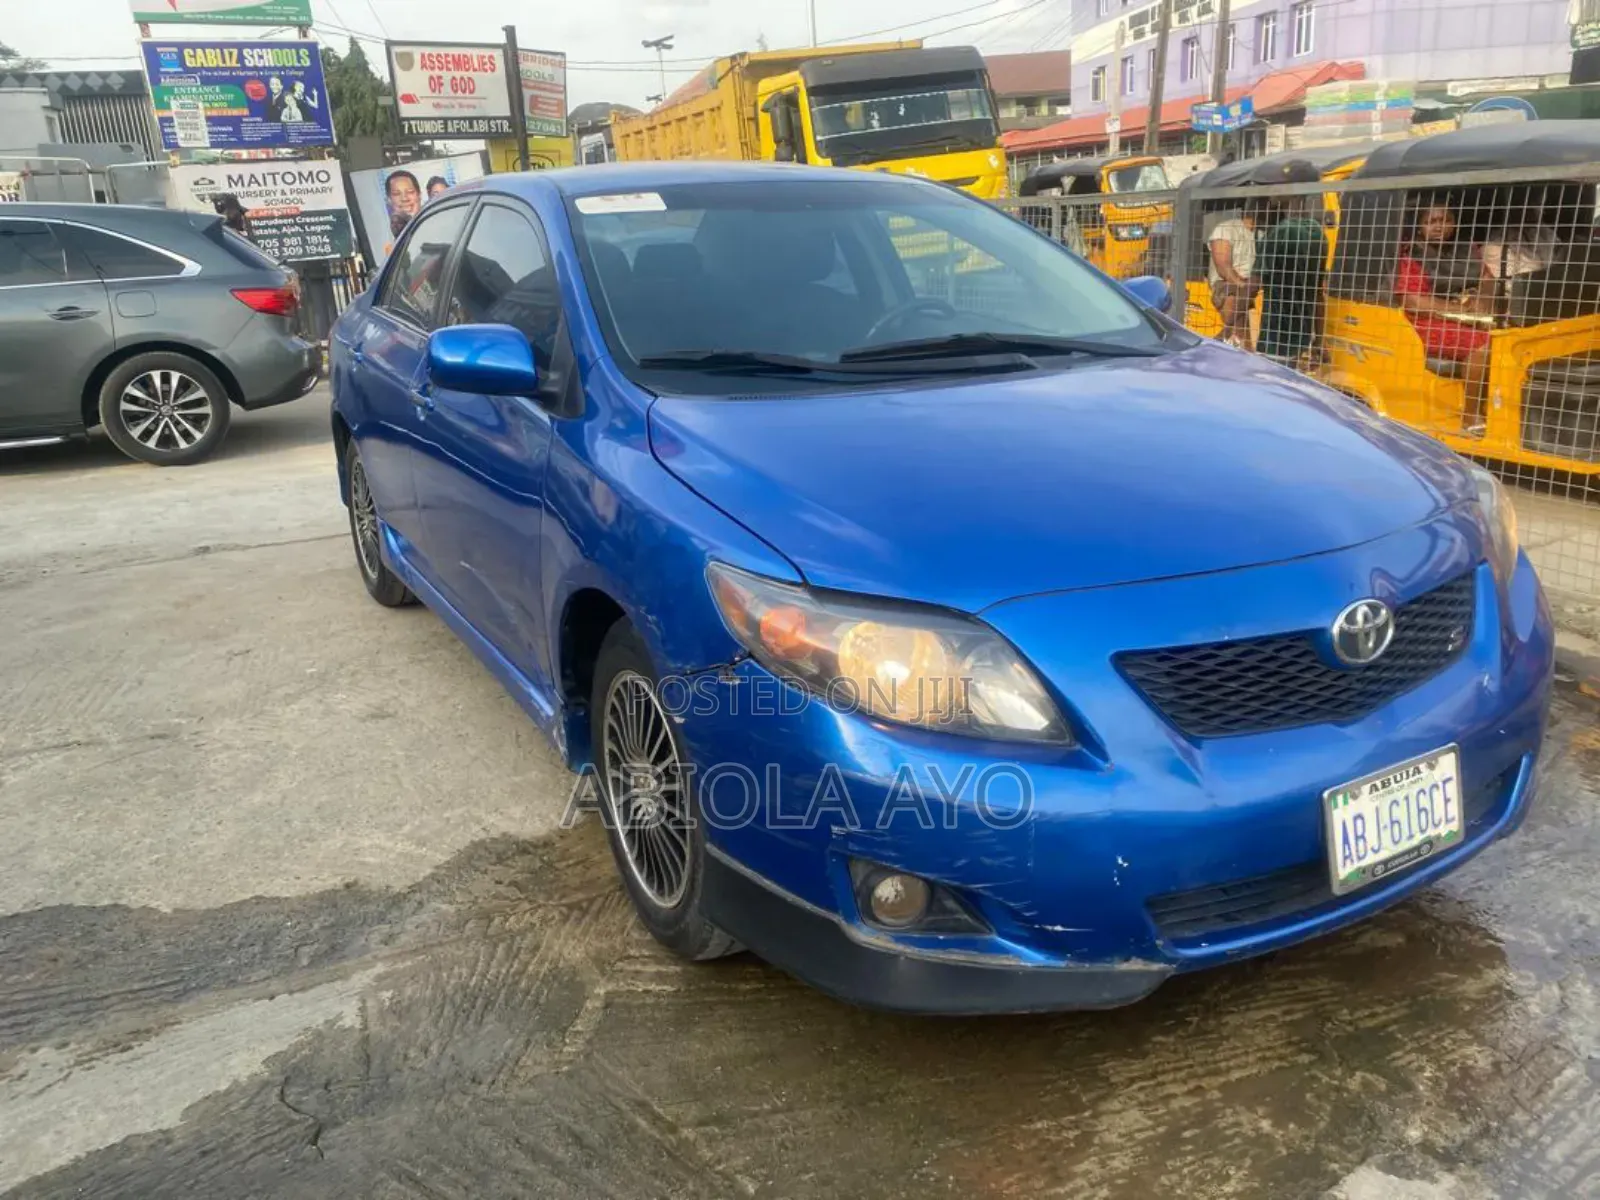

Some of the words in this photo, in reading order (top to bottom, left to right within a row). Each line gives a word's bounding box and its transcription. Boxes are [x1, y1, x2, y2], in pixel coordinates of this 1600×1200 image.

[183, 48, 241, 68] GABLIZ
[243, 48, 311, 67] SCHOOLS
[419, 51, 497, 72] ASSEMBLIES
[174, 85, 221, 94] ENTRANCE
[428, 76, 444, 94] OF
[451, 76, 476, 94] GOD
[410, 120, 446, 134] TUNDE
[447, 119, 489, 133] AFOLABI
[226, 169, 332, 189] MAITOMO
[230, 189, 278, 199] NURSERY
[290, 186, 333, 196] PRIMARY
[263, 197, 306, 206] SCHOOL
[258, 238, 279, 248] 705
[282, 236, 302, 246] 981
[305, 235, 330, 244] 1814
[265, 247, 280, 257] 03
[282, 246, 303, 255] 309
[305, 244, 331, 254] 1948
[1369, 765, 1423, 795] ABUJA
[1341, 776, 1456, 869] ABJ-616CE
